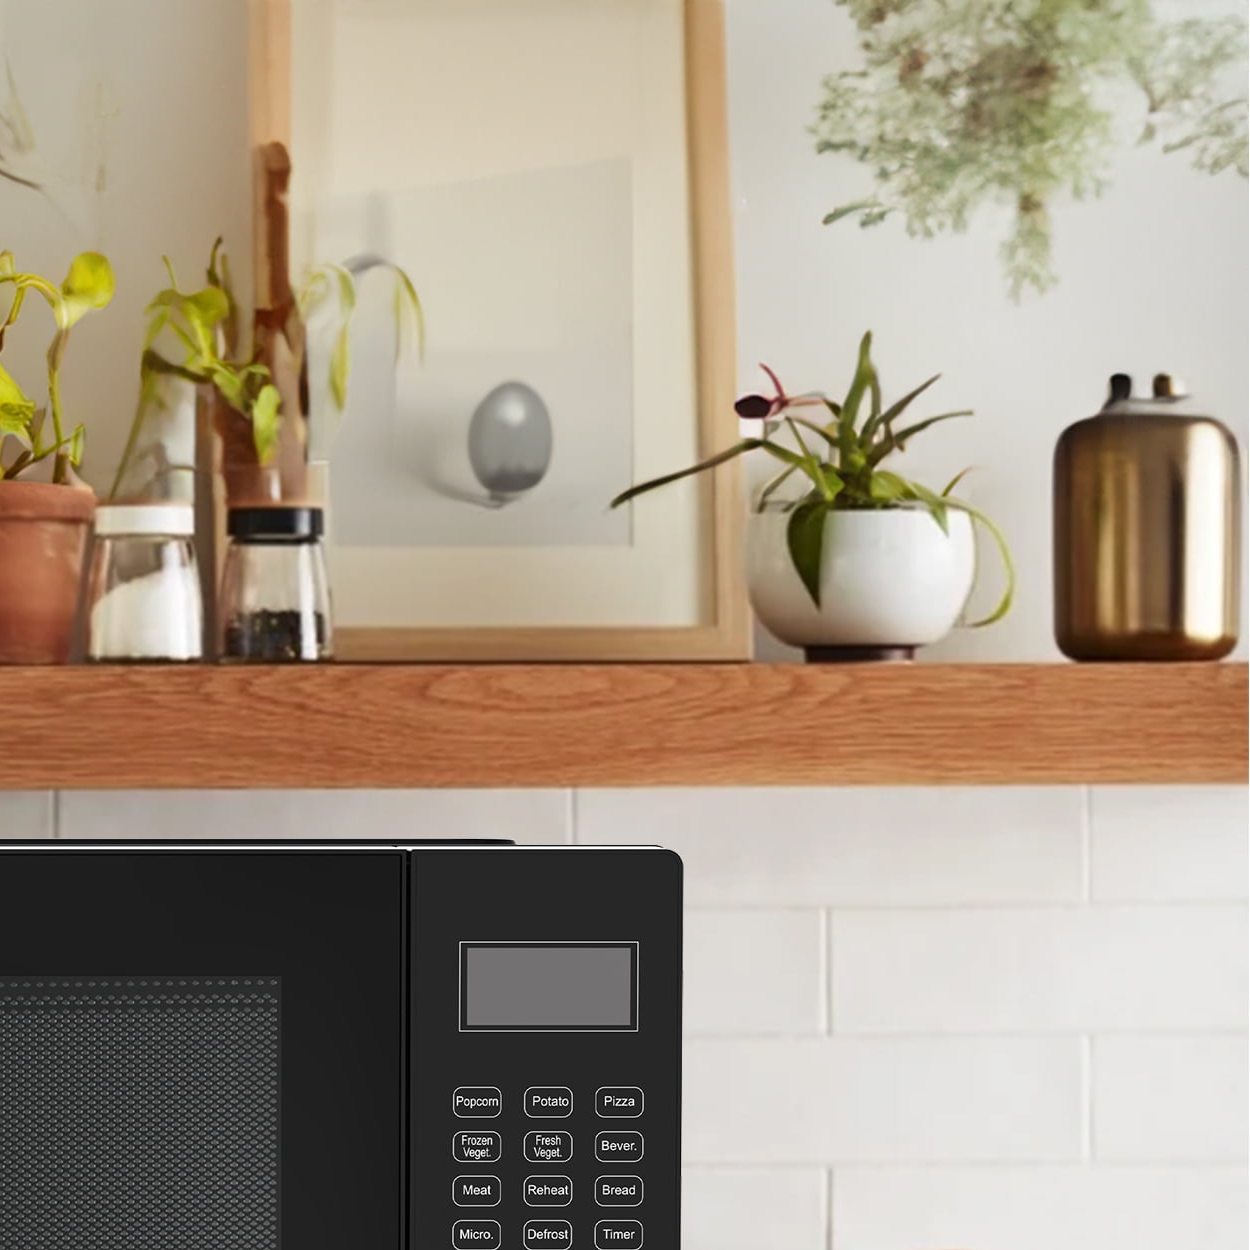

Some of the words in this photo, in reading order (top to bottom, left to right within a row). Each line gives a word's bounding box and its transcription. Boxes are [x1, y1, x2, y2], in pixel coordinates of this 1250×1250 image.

[456, 1096, 498, 1109] Popcorn
[533, 1096, 569, 1106] Potato
[605, 1096, 635, 1106] Pizza
[462, 1135, 493, 1145] Frozen
[536, 1135, 561, 1145] Fresh
[602, 1140, 637, 1151] Bever.
[463, 1147, 491, 1159] Veget.
[534, 1147, 562, 1159] Veget.
[463, 1185, 491, 1195] Meat
[528, 1185, 568, 1195] Reheat
[603, 1185, 635, 1195] Bread
[460, 1229, 493, 1239] Micro.
[528, 1229, 568, 1239] Defrost
[603, 1229, 635, 1239] Timer
